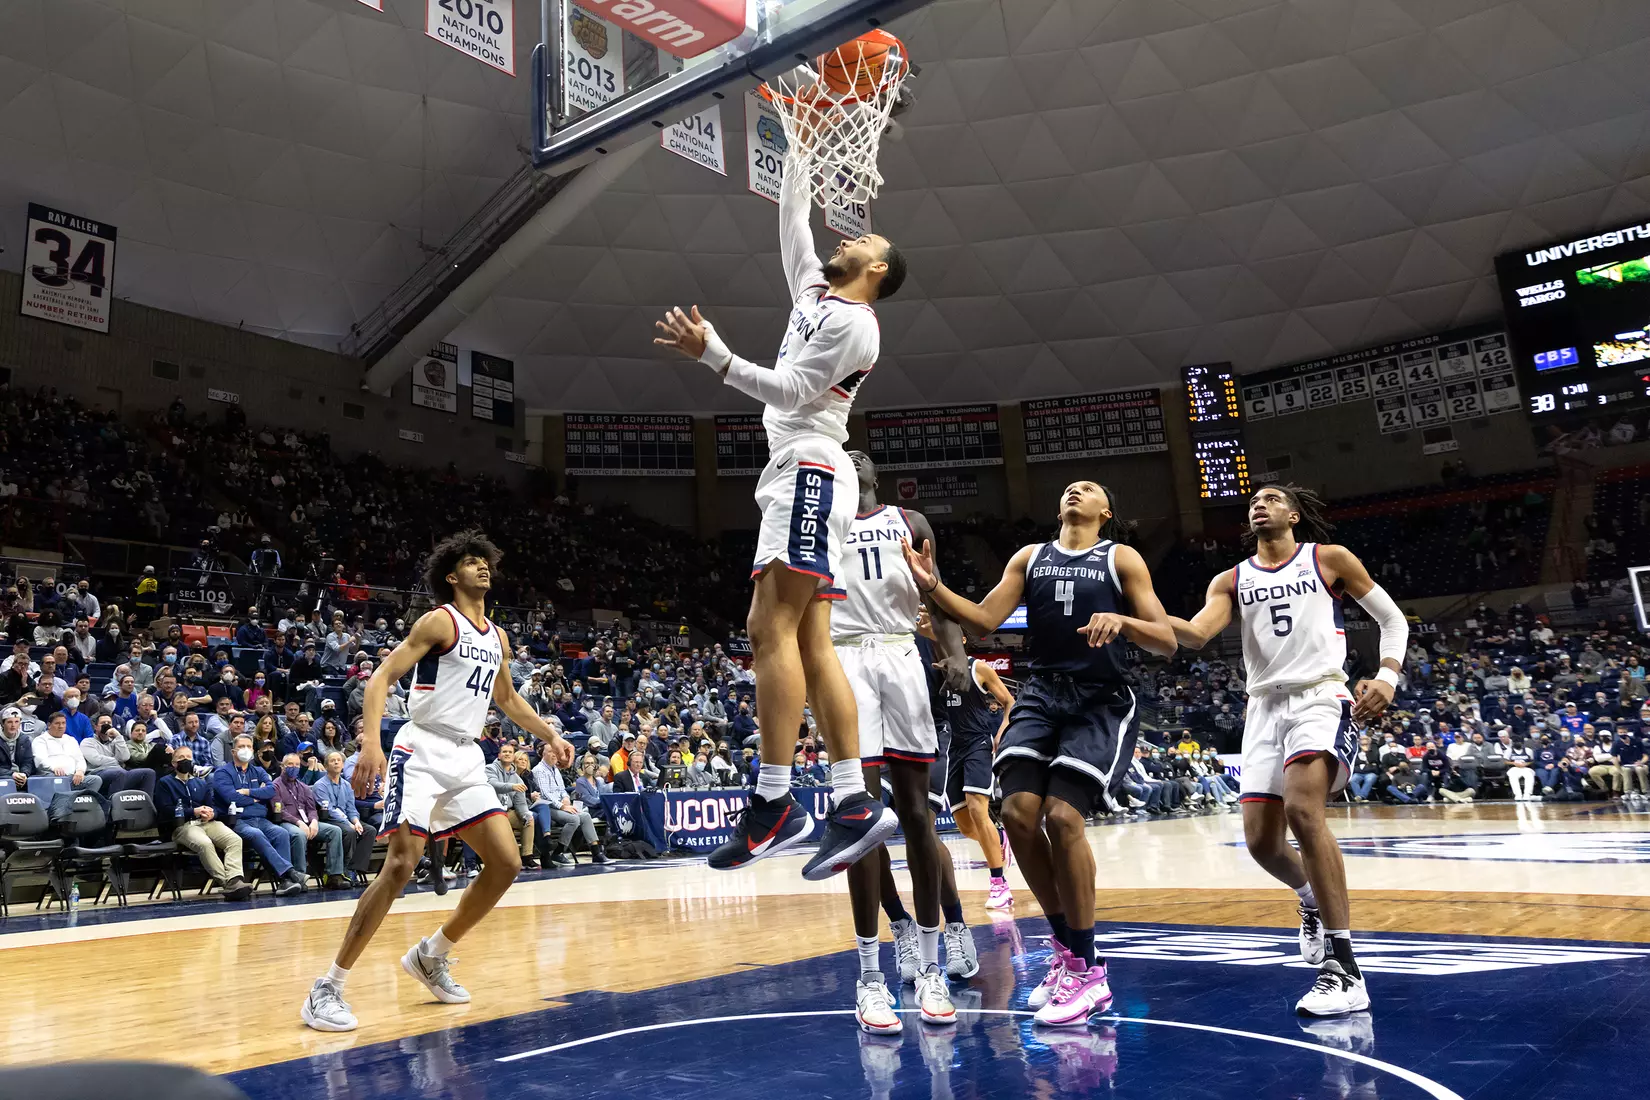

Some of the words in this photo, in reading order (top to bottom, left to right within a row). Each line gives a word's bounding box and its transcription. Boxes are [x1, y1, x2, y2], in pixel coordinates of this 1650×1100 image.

[443, 14, 500, 50] NATIONAL
[437, 27, 505, 66] CHAMPIONS
[567, 50, 616, 92] 2013
[678, 115, 716, 142] 014
[672, 127, 715, 154] NATIONAL
[669, 139, 720, 169] CHAMPIONS
[755, 149, 783, 179] 201
[755, 182, 781, 201] CHAMP
[48, 211, 67, 225] RAY
[70, 219, 98, 234] ALLEN
[832, 209, 866, 232] NATIONAL
[1525, 222, 1650, 266] UNIVERSITY
[32, 228, 105, 298] 34
[1515, 279, 1565, 297] WELLS
[1519, 290, 1567, 307] FARGO
[26, 301, 65, 315] NUMBER
[67, 311, 105, 324] RETIRED
[1293, 360, 1328, 373] UCONN
[1332, 349, 1379, 365] HUSKIES
[1384, 345, 1397, 353] OF
[1402, 335, 1441, 349] HONOR
[1481, 350, 1508, 367] 42
[1534, 348, 1573, 364] CBS
[1377, 372, 1400, 388] 42
[1410, 365, 1434, 381] 44
[1310, 387, 1333, 402] 22
[1342, 380, 1366, 396] 25
[222, 393, 239, 403] 210
[1029, 401, 1059, 410] NCAA
[1065, 391, 1153, 406] CHAMPIONSHIP
[1253, 400, 1266, 413] C
[1285, 394, 1295, 407] 9
[1453, 397, 1476, 413] 22
[872, 411, 905, 419] NATIONAL
[908, 409, 944, 417] INVITATION
[946, 406, 992, 415] TOURNAMENT
[1029, 407, 1085, 417] TOURNAMENT
[1090, 400, 1155, 411] APPEARANCES
[1419, 404, 1439, 419] 13
[567, 415, 585, 423] BIG
[590, 415, 618, 423] EAST
[621, 415, 692, 424] CONFERENCE
[902, 416, 963, 425] APPEARANCES
[1382, 410, 1406, 427] 24
[952, 458, 999, 467] BASKETBALL
[1030, 452, 1083, 462] CONNECTICUT
[1087, 449, 1109, 458] MEN'S
[1113, 446, 1162, 456] BASKETBALL
[800, 472, 822, 563] HUSKIES
[846, 528, 907, 544] CONN
[857, 546, 883, 581] 11
[1032, 565, 1106, 583] GEORGETOWN
[179, 590, 196, 599] SEC
[199, 589, 227, 604] 109
[1054, 579, 1075, 616] 4
[1240, 579, 1318, 606] UCONN
[1269, 603, 1293, 637] 5
[1416, 622, 1439, 633] 114
[465, 665, 495, 700] 44
[385, 754, 403, 824] HUSKIES
[6, 797, 36, 805] UCONN
[120, 794, 146, 802] UCONN
